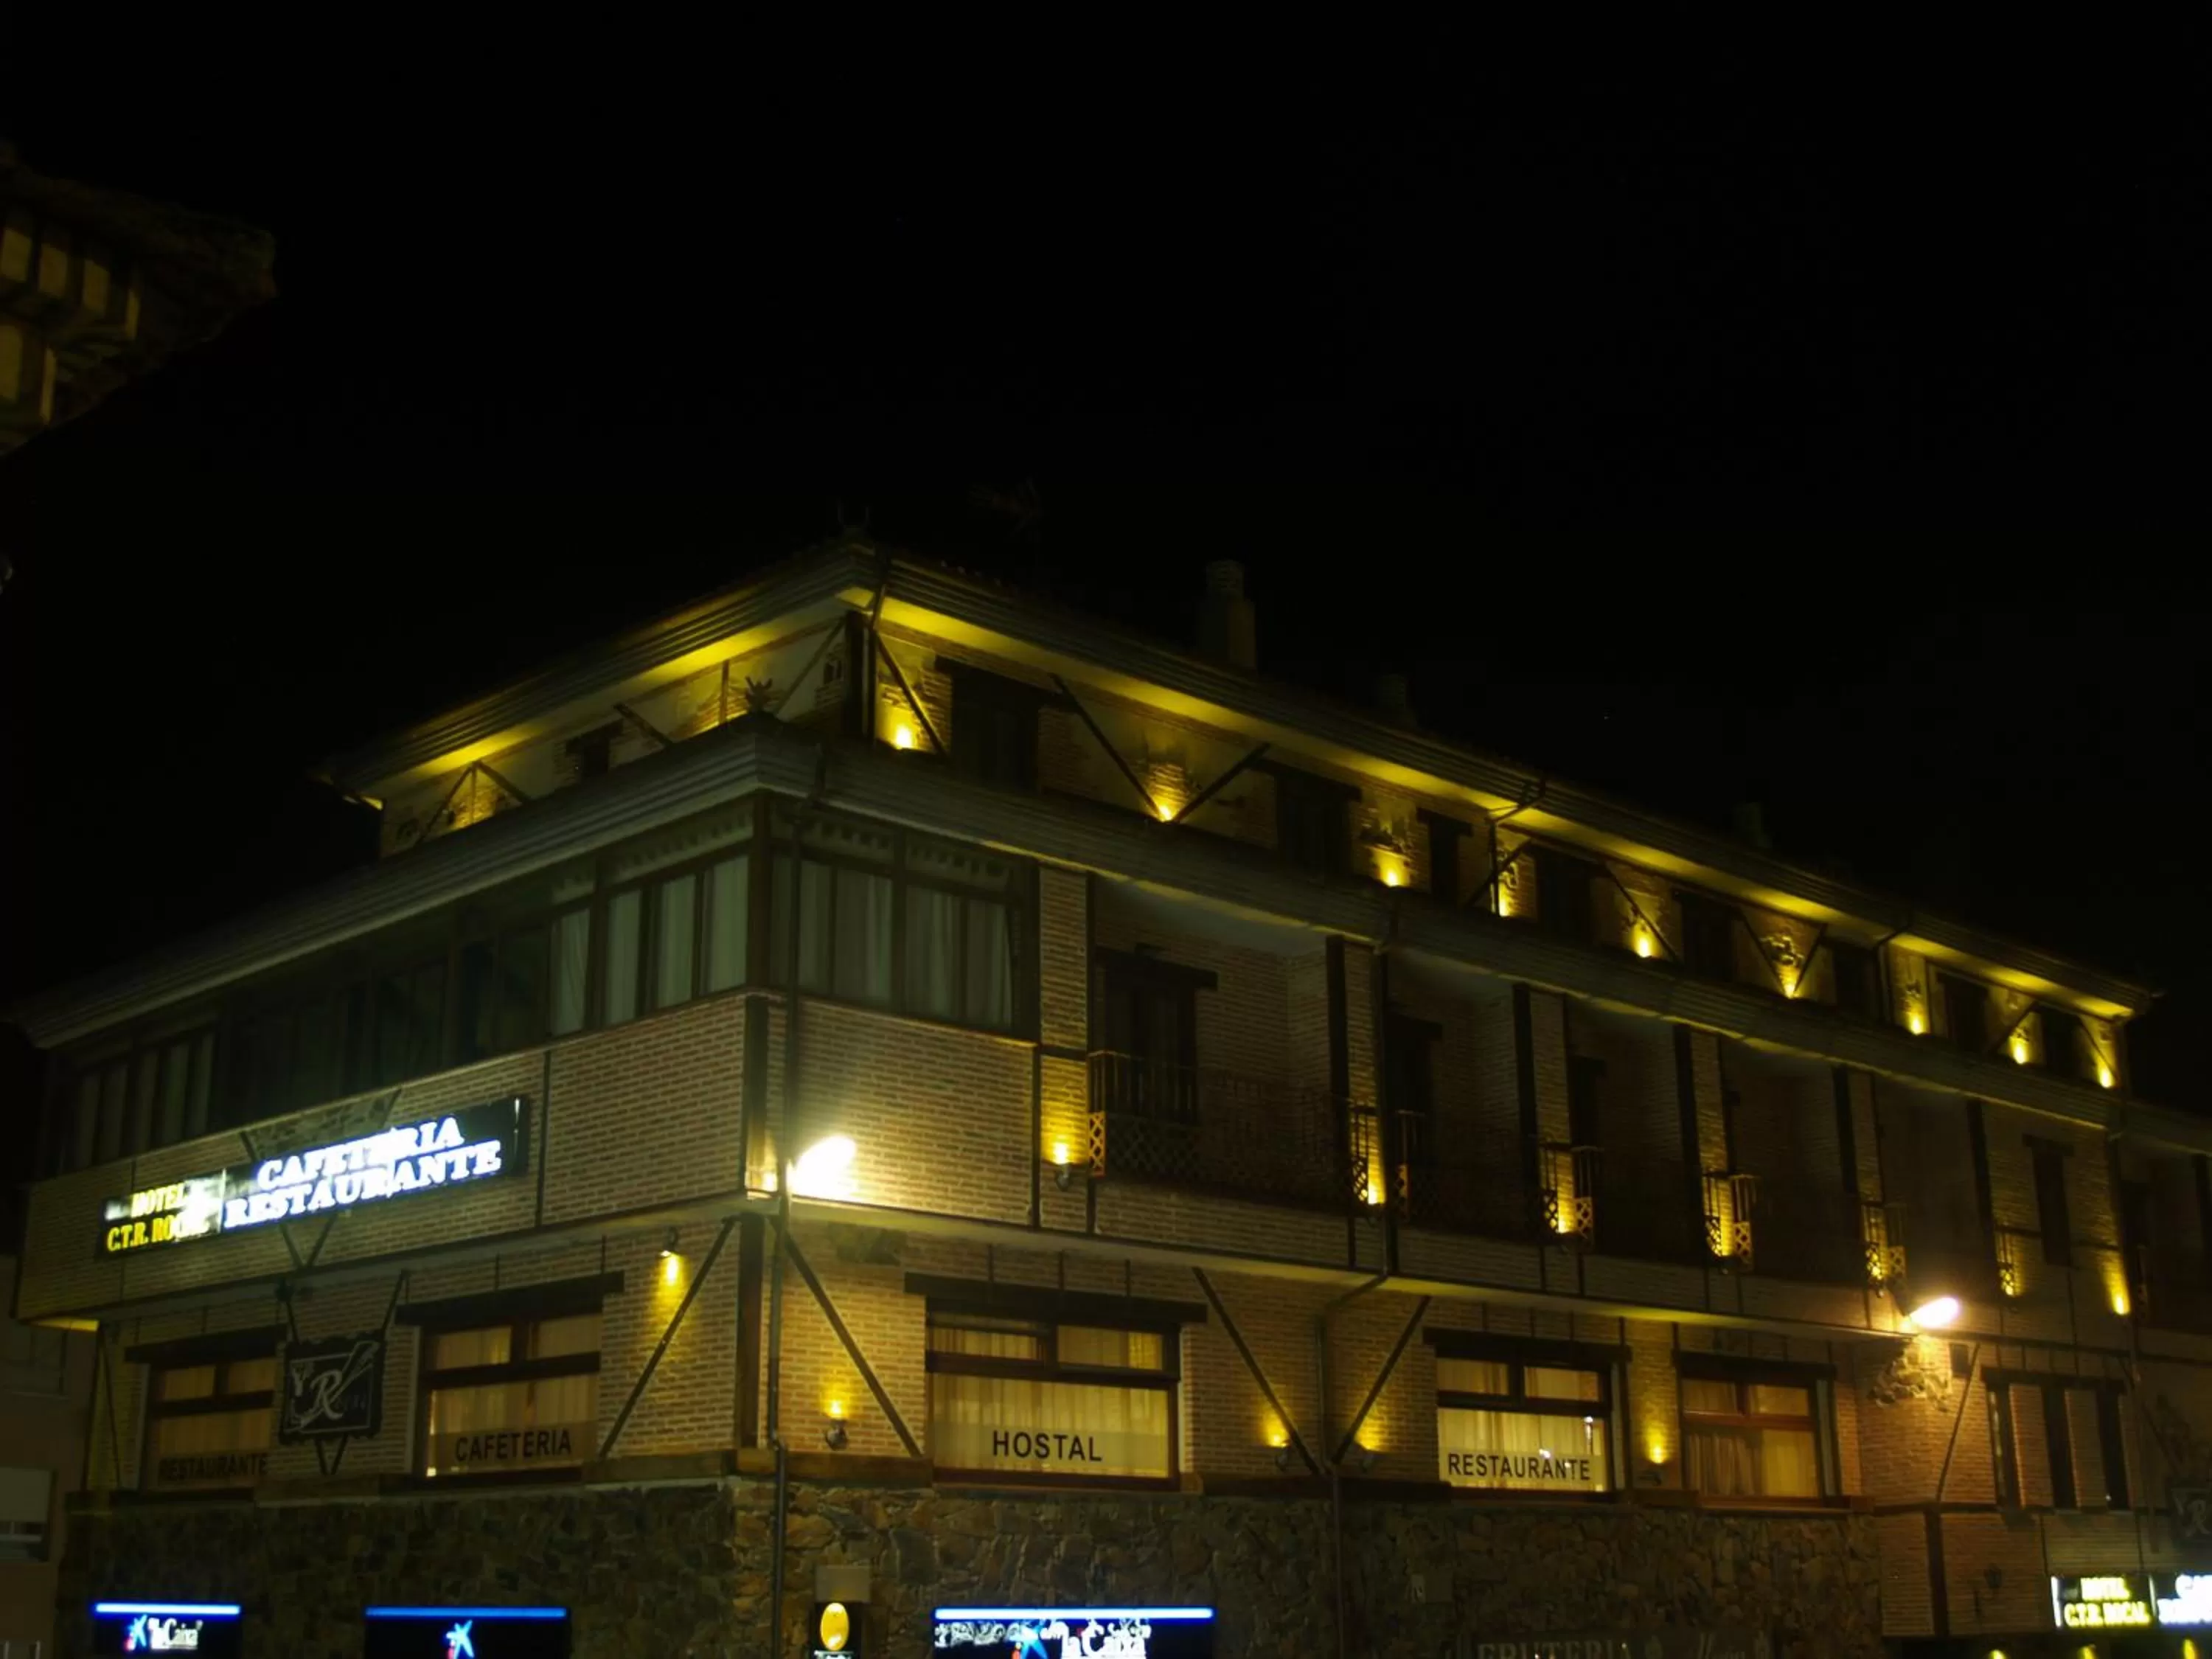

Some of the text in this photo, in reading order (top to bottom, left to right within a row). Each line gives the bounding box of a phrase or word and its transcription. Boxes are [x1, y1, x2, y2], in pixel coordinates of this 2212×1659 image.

[258, 1118, 464, 1189] CAFETERIA
[131, 1183, 188, 1217] HOTEL
[224, 1141, 501, 1228] RESTAURANTE
[455, 1427, 571, 1462] CAFETERIA
[992, 1430, 1103, 1461] HOSTAL
[159, 1453, 268, 1481] RESTAURANTE
[1447, 1453, 1591, 1481] RESTAURANTE
